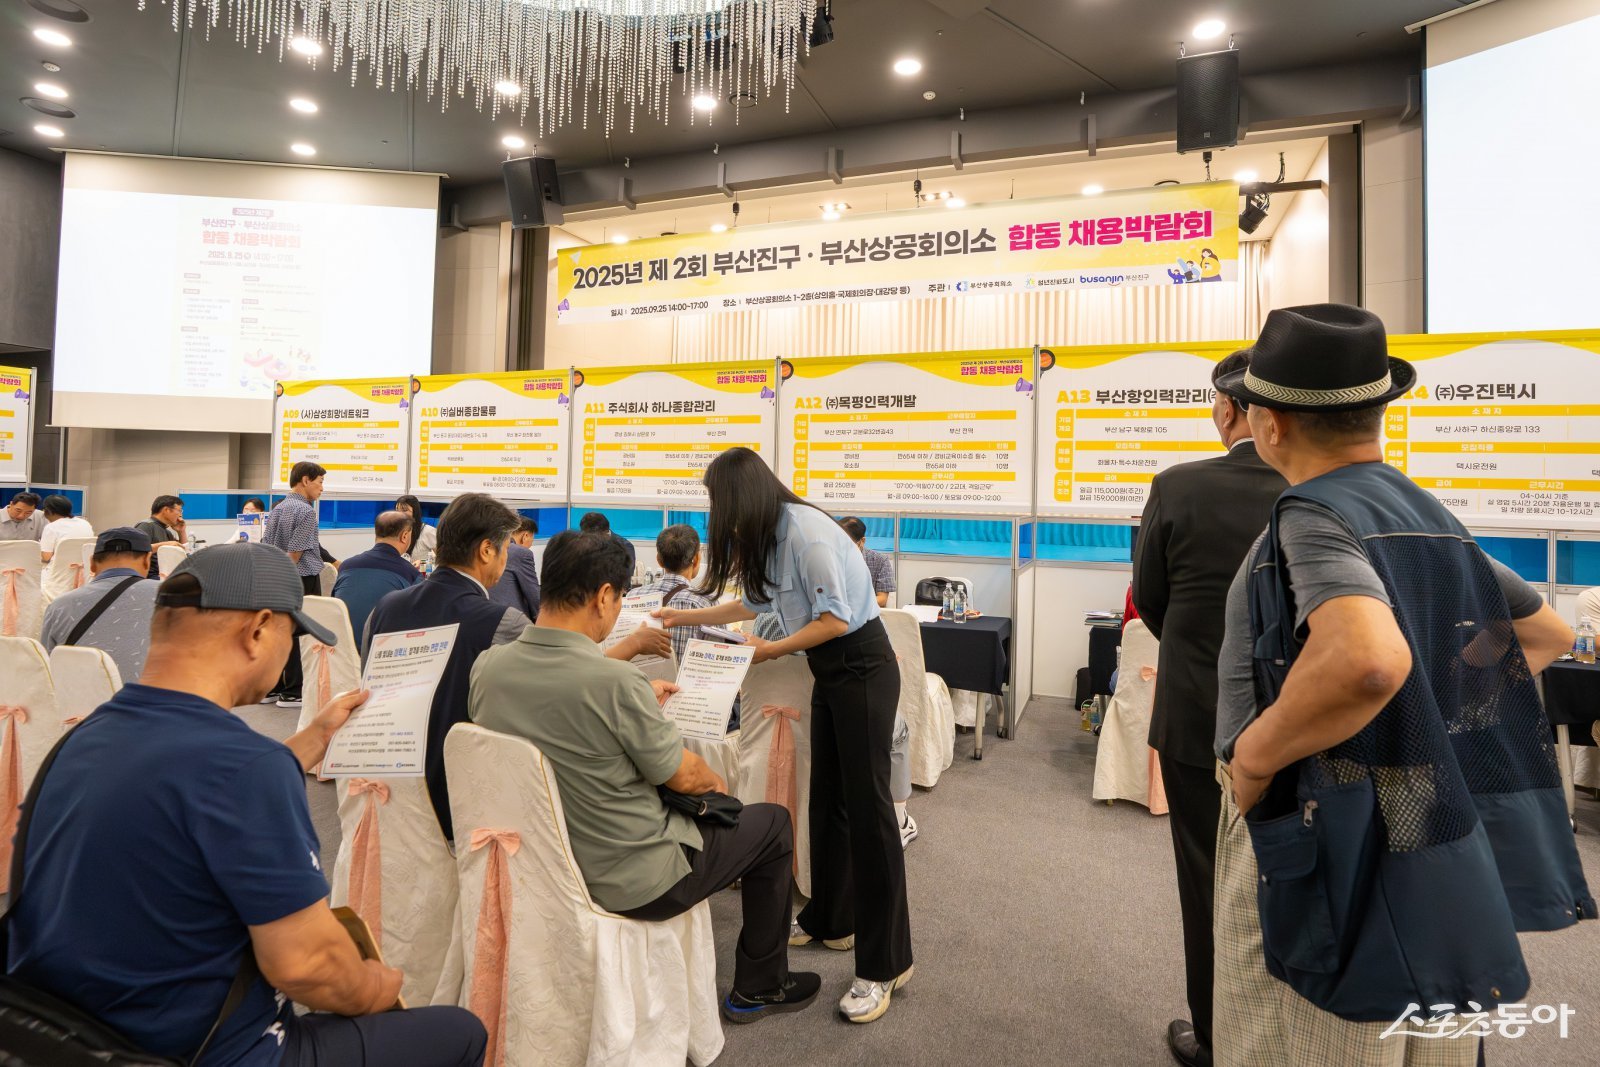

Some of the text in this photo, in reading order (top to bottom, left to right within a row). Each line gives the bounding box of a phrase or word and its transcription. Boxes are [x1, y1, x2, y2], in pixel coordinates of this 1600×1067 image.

[573, 210, 1212, 289] 2025년 제 2회 부산진구 부산상공회의소 합동 채용박람회
[1080, 275, 1124, 284] busanjin
[1126, 274, 1150, 282] 부산진구
[928, 284, 946, 293] 주관
[970, 280, 1012, 290] 부산상공회의소
[723, 298, 736, 307] 장소
[746, 294, 792, 306] 부산상공회의소
[611, 308, 623, 316] 일시
[630, 302, 667, 316] 2025.09.25
[961, 364, 1022, 376] 합동 채용박람회
[1057, 390, 1091, 403] A13
[1398, 386, 1429, 399] 14
[584, 400, 716, 414] A11 주식회사 하나종합관리
[794, 397, 822, 409] A12
[283, 409, 370, 420] A09 (사)삼성희망네트워크
[421, 408, 438, 417] A10
[1456, 462, 1497, 471] 택시운전원
[1529, 481, 1564, 490] 근무시간
